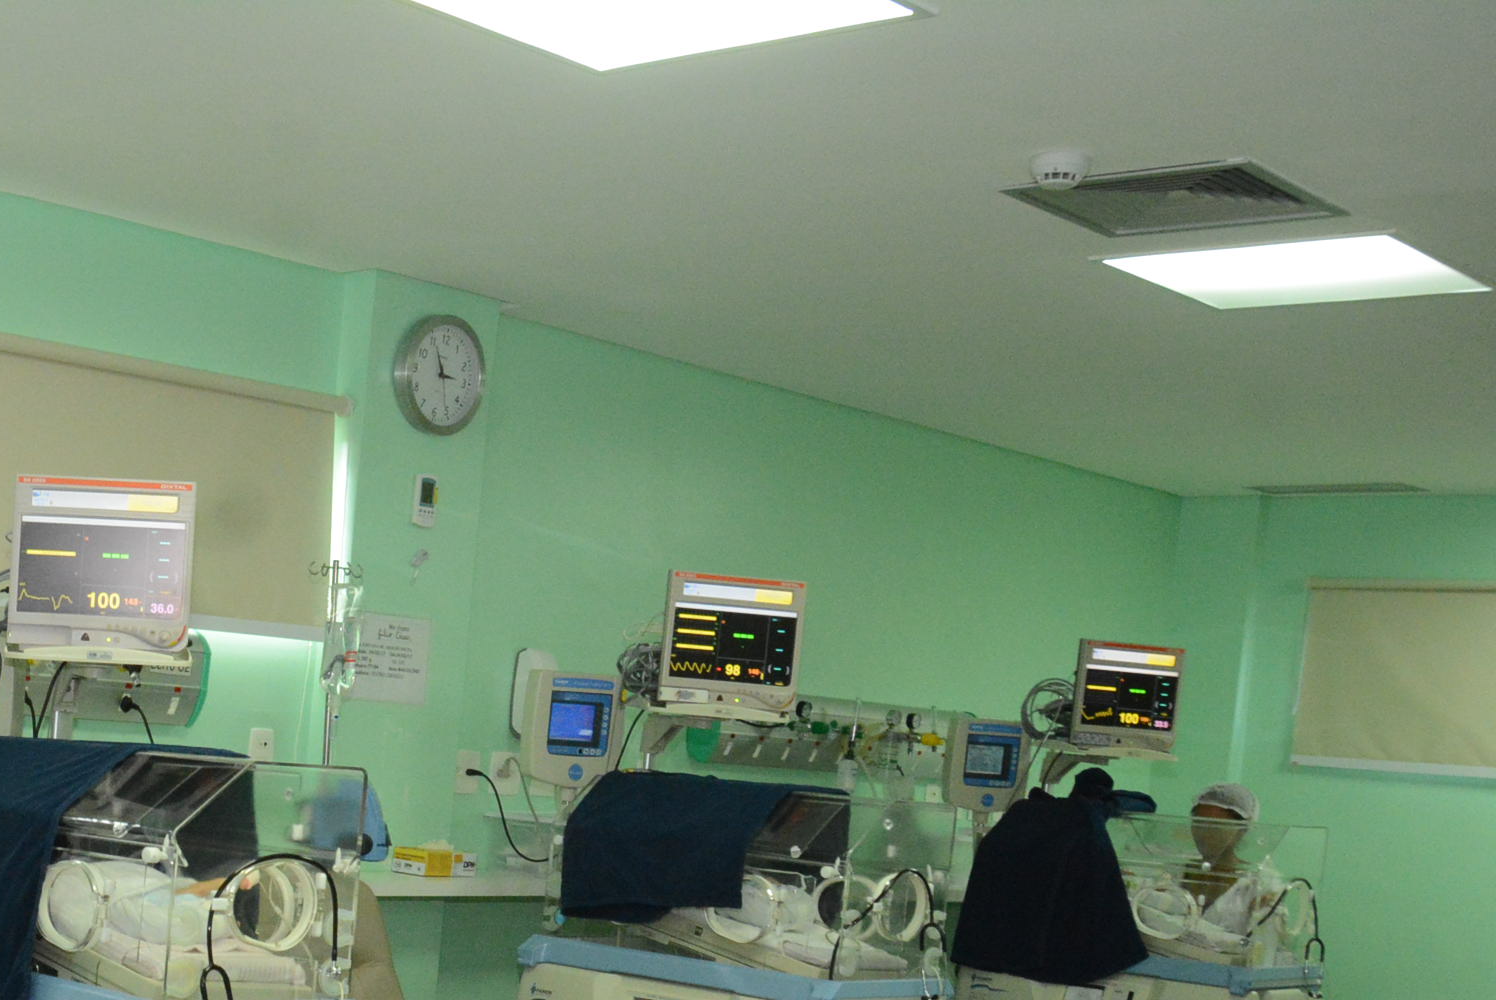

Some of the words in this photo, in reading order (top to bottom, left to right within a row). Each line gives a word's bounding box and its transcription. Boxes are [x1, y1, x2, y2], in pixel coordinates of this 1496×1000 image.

[87, 591, 120, 609] 100
[150, 603, 174, 614] 36.0
[724, 663, 741, 677] 98
[1119, 712, 1140, 725] 100
